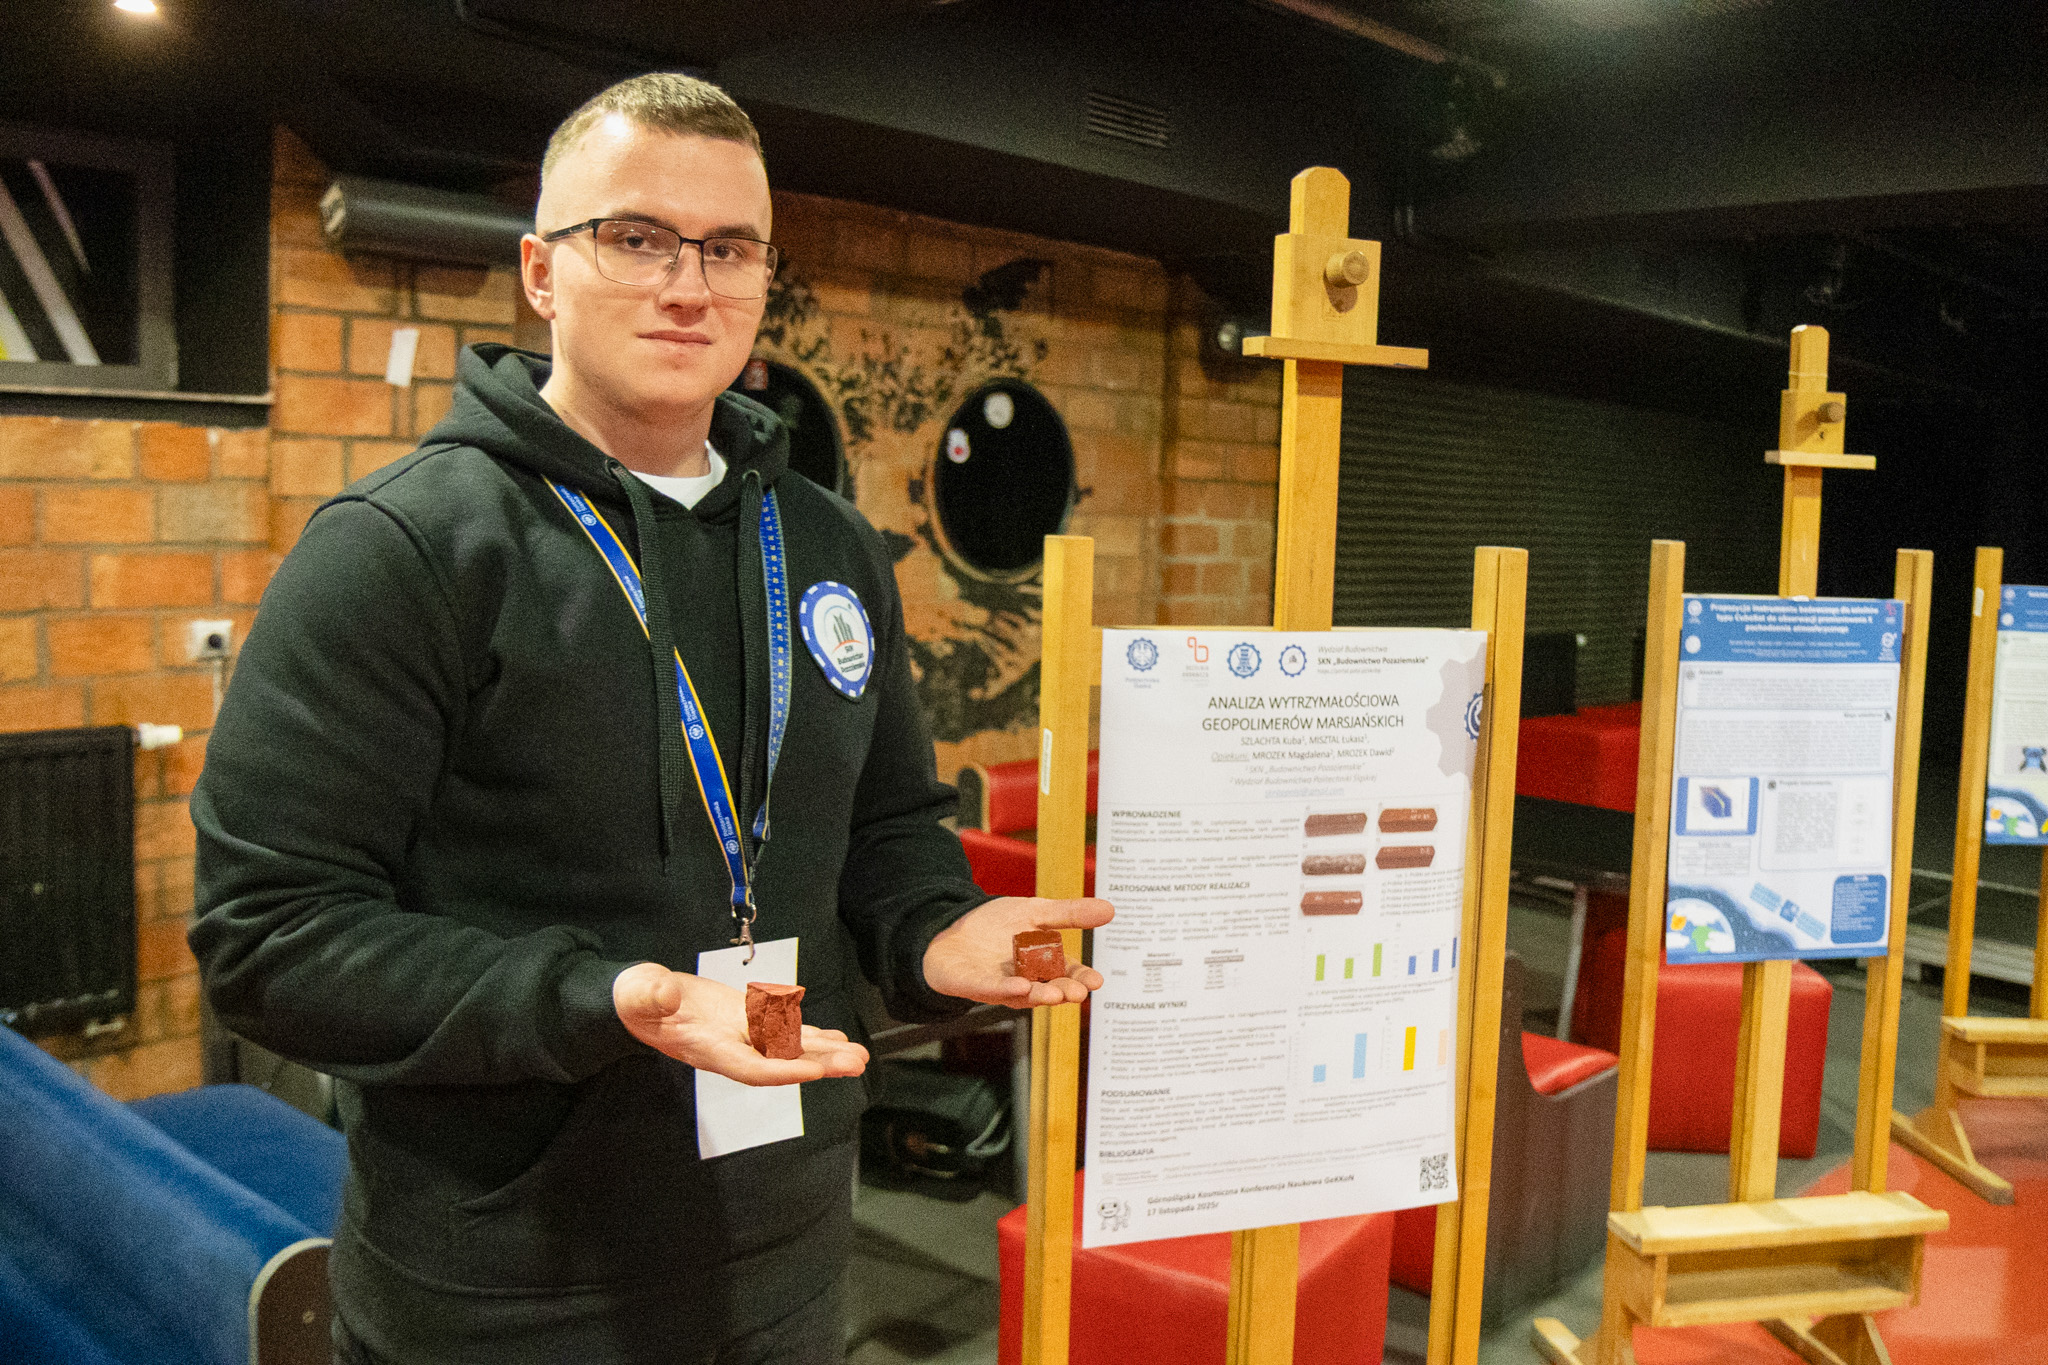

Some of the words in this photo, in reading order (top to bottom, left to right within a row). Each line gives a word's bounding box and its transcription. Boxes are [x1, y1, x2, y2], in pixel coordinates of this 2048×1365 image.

[1317, 657, 1331, 665] SKN
[1208, 696, 1265, 709] ANALIZA
[1269, 692, 1400, 709] WYTRZYMAŁOŚCIOWA
[1202, 714, 1313, 731] GEOPOLIMERÓW
[1316, 713, 1404, 729] MARSJAŃSKICH
[1240, 736, 1281, 746] SZLACHTA
[1309, 735, 1340, 745] MISZTAL
[1252, 751, 1286, 760] MROZEK
[1337, 749, 1368, 759] MROZEK
[1112, 810, 1181, 818] WPROWADZENIE
[1109, 884, 1171, 892] ZASTOSOWANE
[1174, 883, 1207, 891] METODY
[1104, 1001, 1156, 1010] OTRZYMANE
[1101, 1088, 1171, 1097] PODSUMOWANIE
[1099, 1148, 1154, 1158] BIBLIOGRAFIA
[1198, 1189, 1238, 1198] Kosmiczna
[1240, 1183, 1285, 1193] Konferencja
[1287, 1179, 1322, 1188] Naukowa
[1159, 1205, 1195, 1215] listopada
